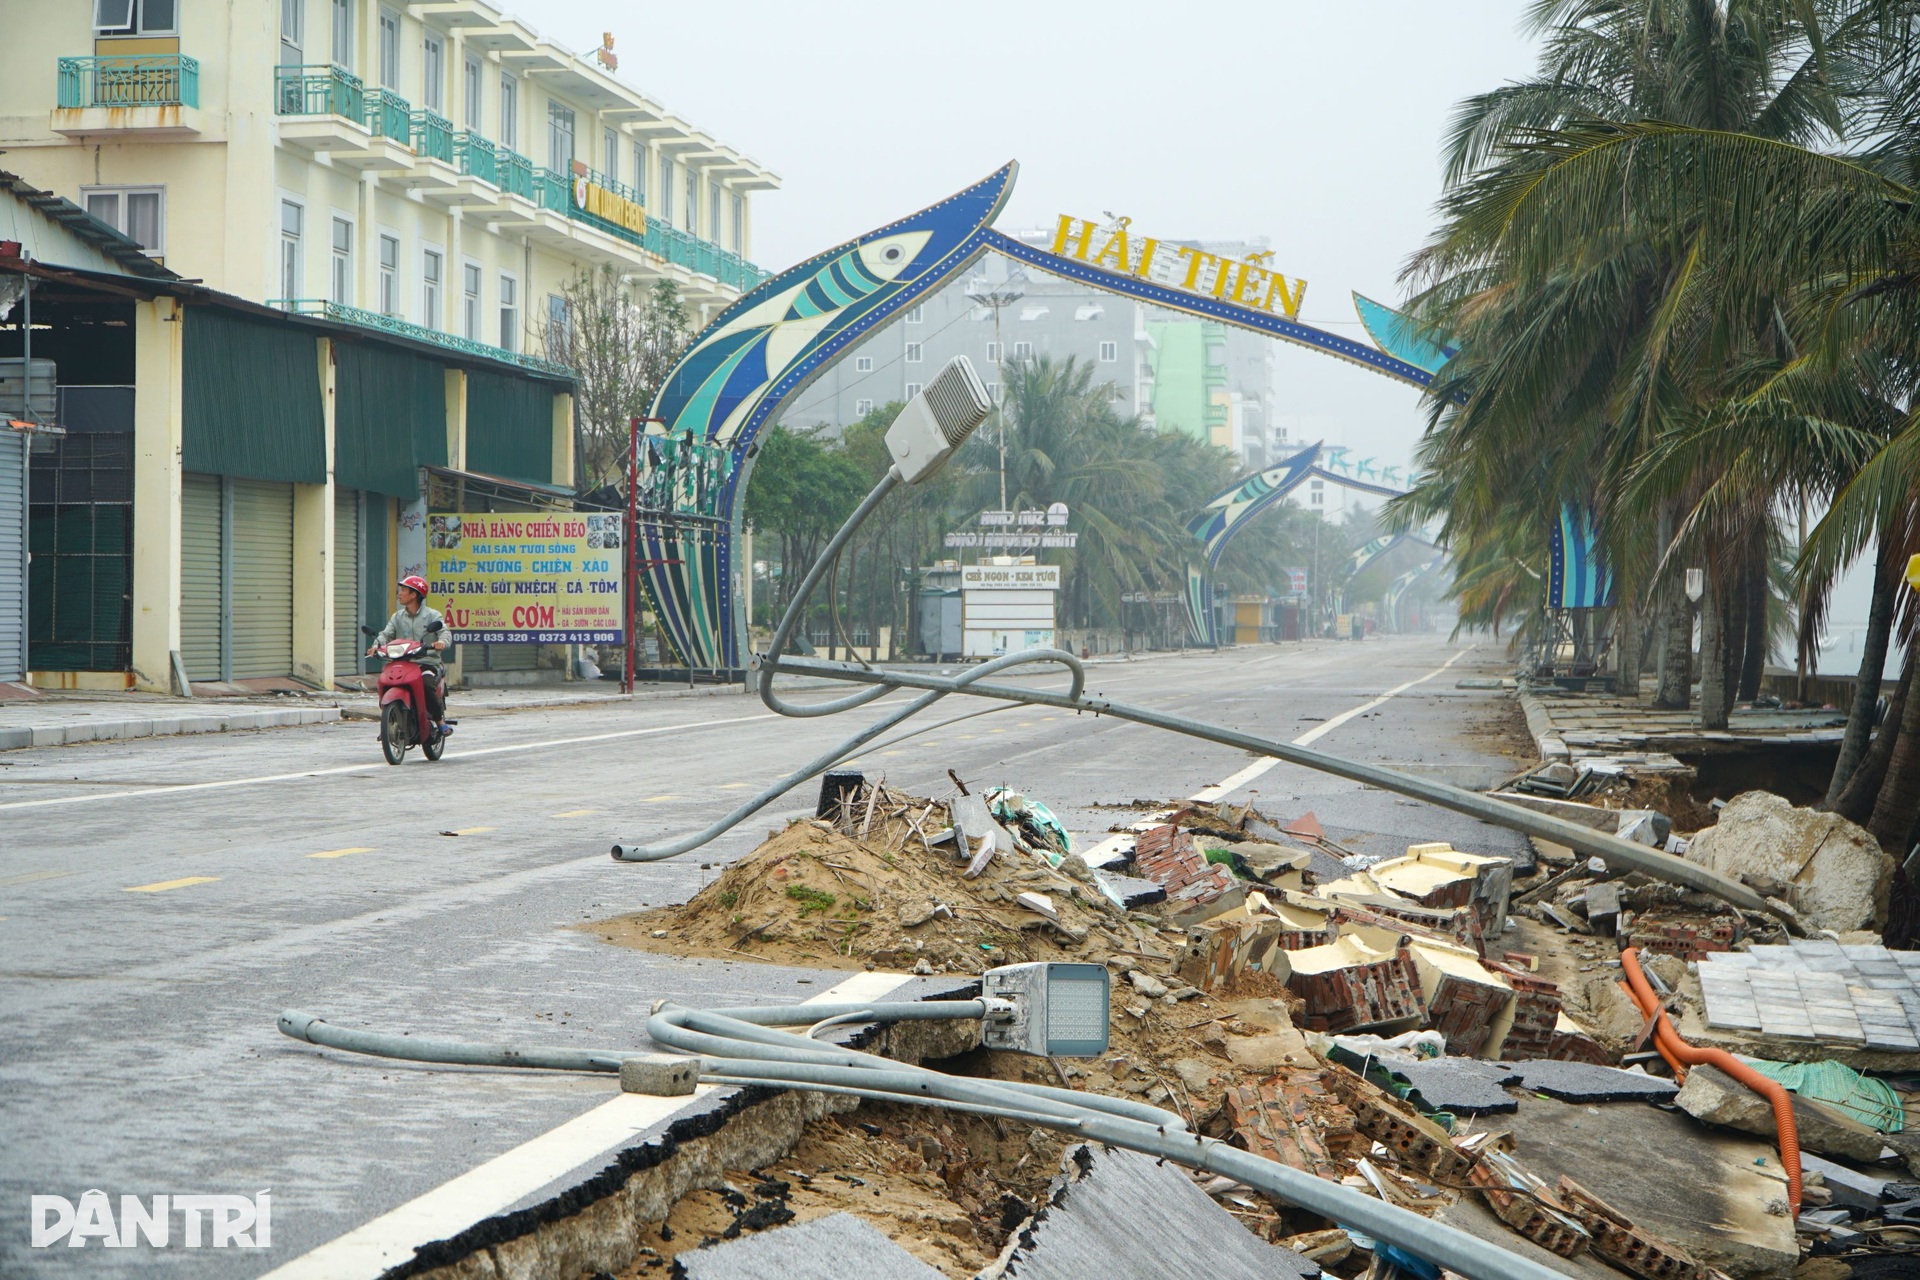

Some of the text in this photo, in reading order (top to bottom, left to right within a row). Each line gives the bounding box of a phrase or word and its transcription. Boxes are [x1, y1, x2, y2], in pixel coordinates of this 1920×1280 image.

[1050, 214, 1308, 318] HẢI TIẾN
[463, 515, 586, 538] NHÀ HÀNG CHIẾN BÉO
[472, 542, 576, 554] HẢI SẢN TƯƠI SỐNG
[440, 555, 609, 573] HẤP NƯỚNG CHIÊN XÀO
[965, 569, 982, 581] CHÈ
[984, 572, 1009, 582] NGON
[1015, 572, 1034, 582] KEM
[431, 579, 455, 597] ĐẶC
[458, 578, 487, 594] SẢN:
[491, 578, 511, 594] GỎI
[514, 579, 557, 597] NHỆCH
[566, 578, 583, 594] CÁ
[512, 601, 555, 628] CƠM
[453, 633, 615, 642] 0912 035 320 0373 413 906
